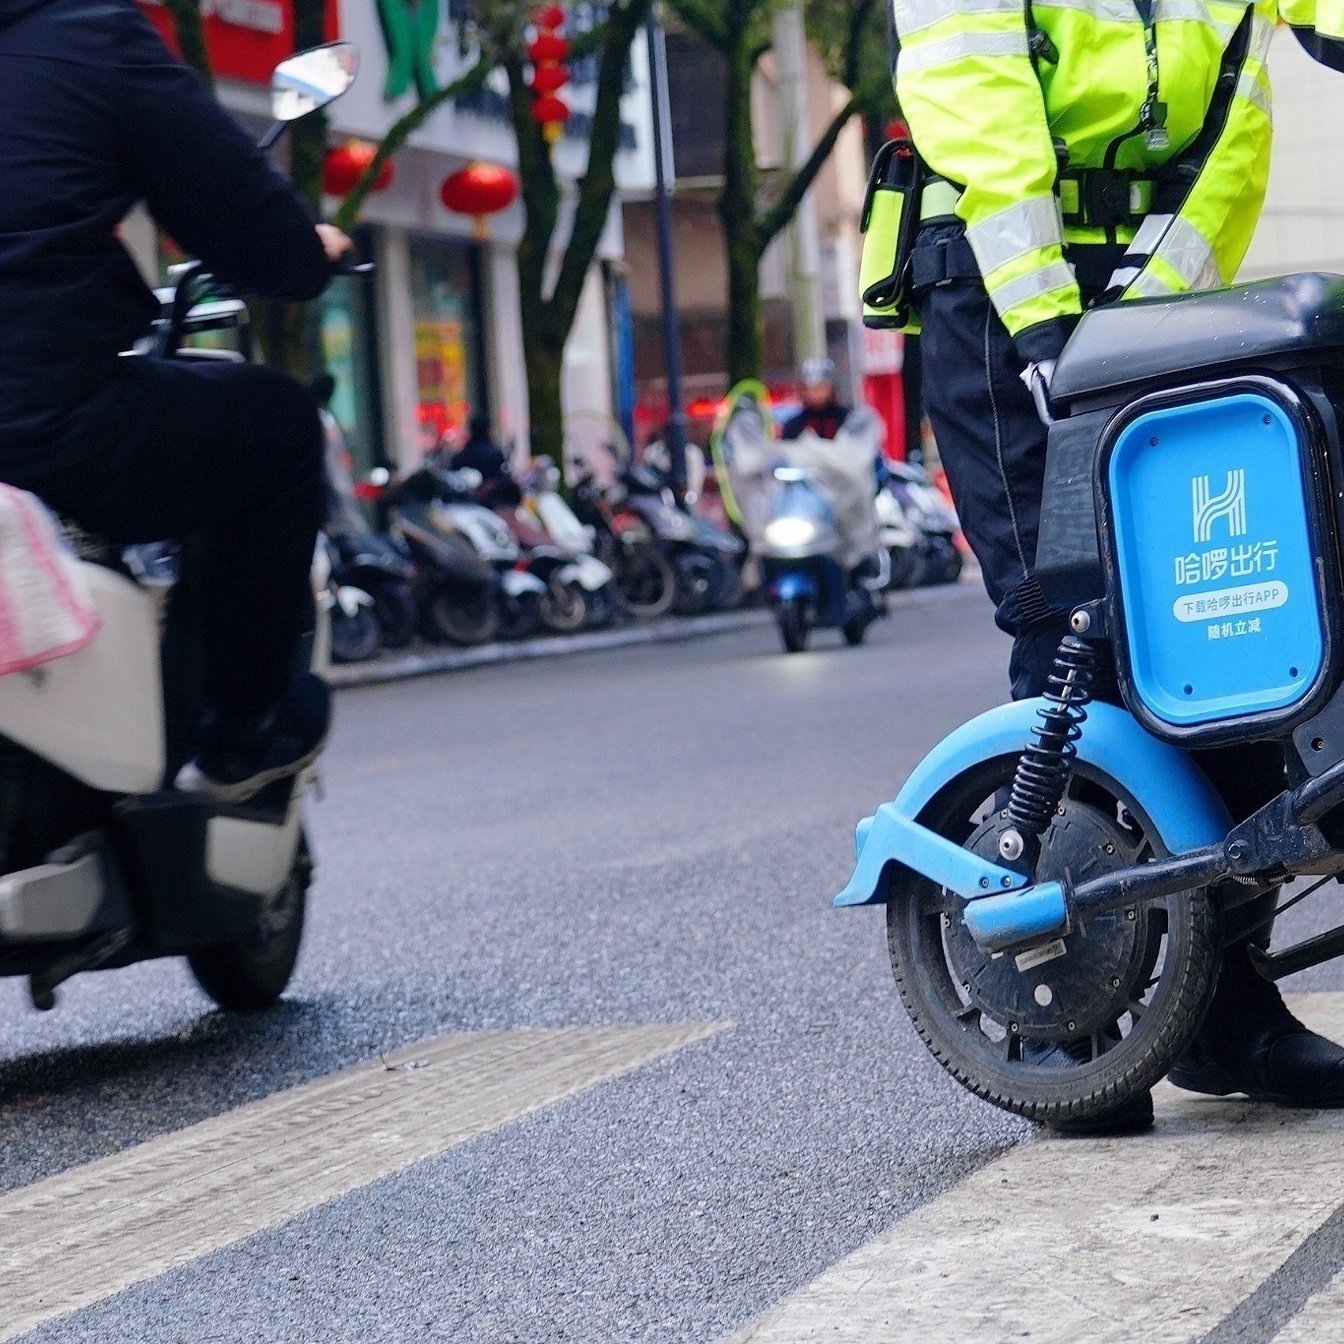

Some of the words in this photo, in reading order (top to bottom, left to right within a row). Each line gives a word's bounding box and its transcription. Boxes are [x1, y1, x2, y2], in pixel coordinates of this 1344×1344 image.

[1175, 539, 1279, 585] 哈啰出行
[1183, 588, 1280, 616] 下载哈啰出行APP
[1207, 617, 1262, 640] 随机立减
